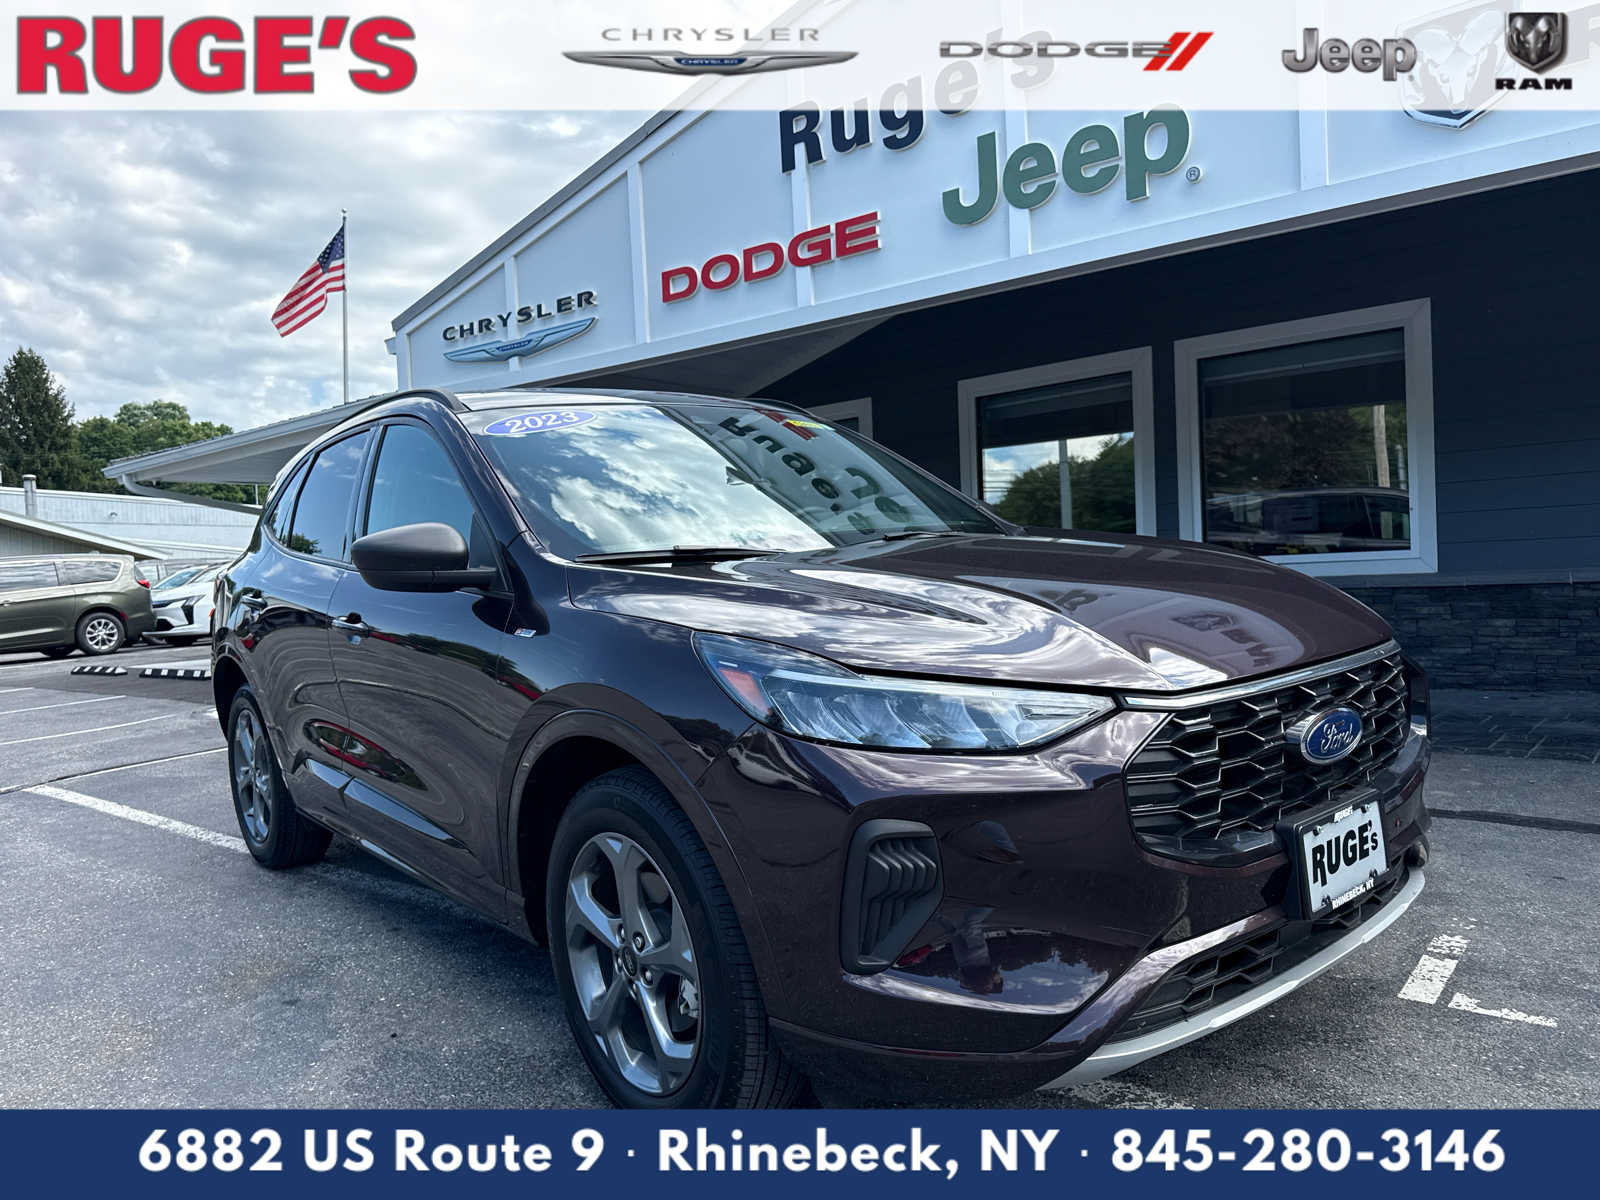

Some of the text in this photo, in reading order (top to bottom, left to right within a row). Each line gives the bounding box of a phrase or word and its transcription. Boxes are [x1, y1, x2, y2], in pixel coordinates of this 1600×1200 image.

[942, 102, 1190, 226] Jeep
[661, 211, 880, 304] DODGE
[442, 290, 597, 342] CHRYSLER
[505, 411, 580, 433] 2023
[1320, 713, 1355, 753] Ford
